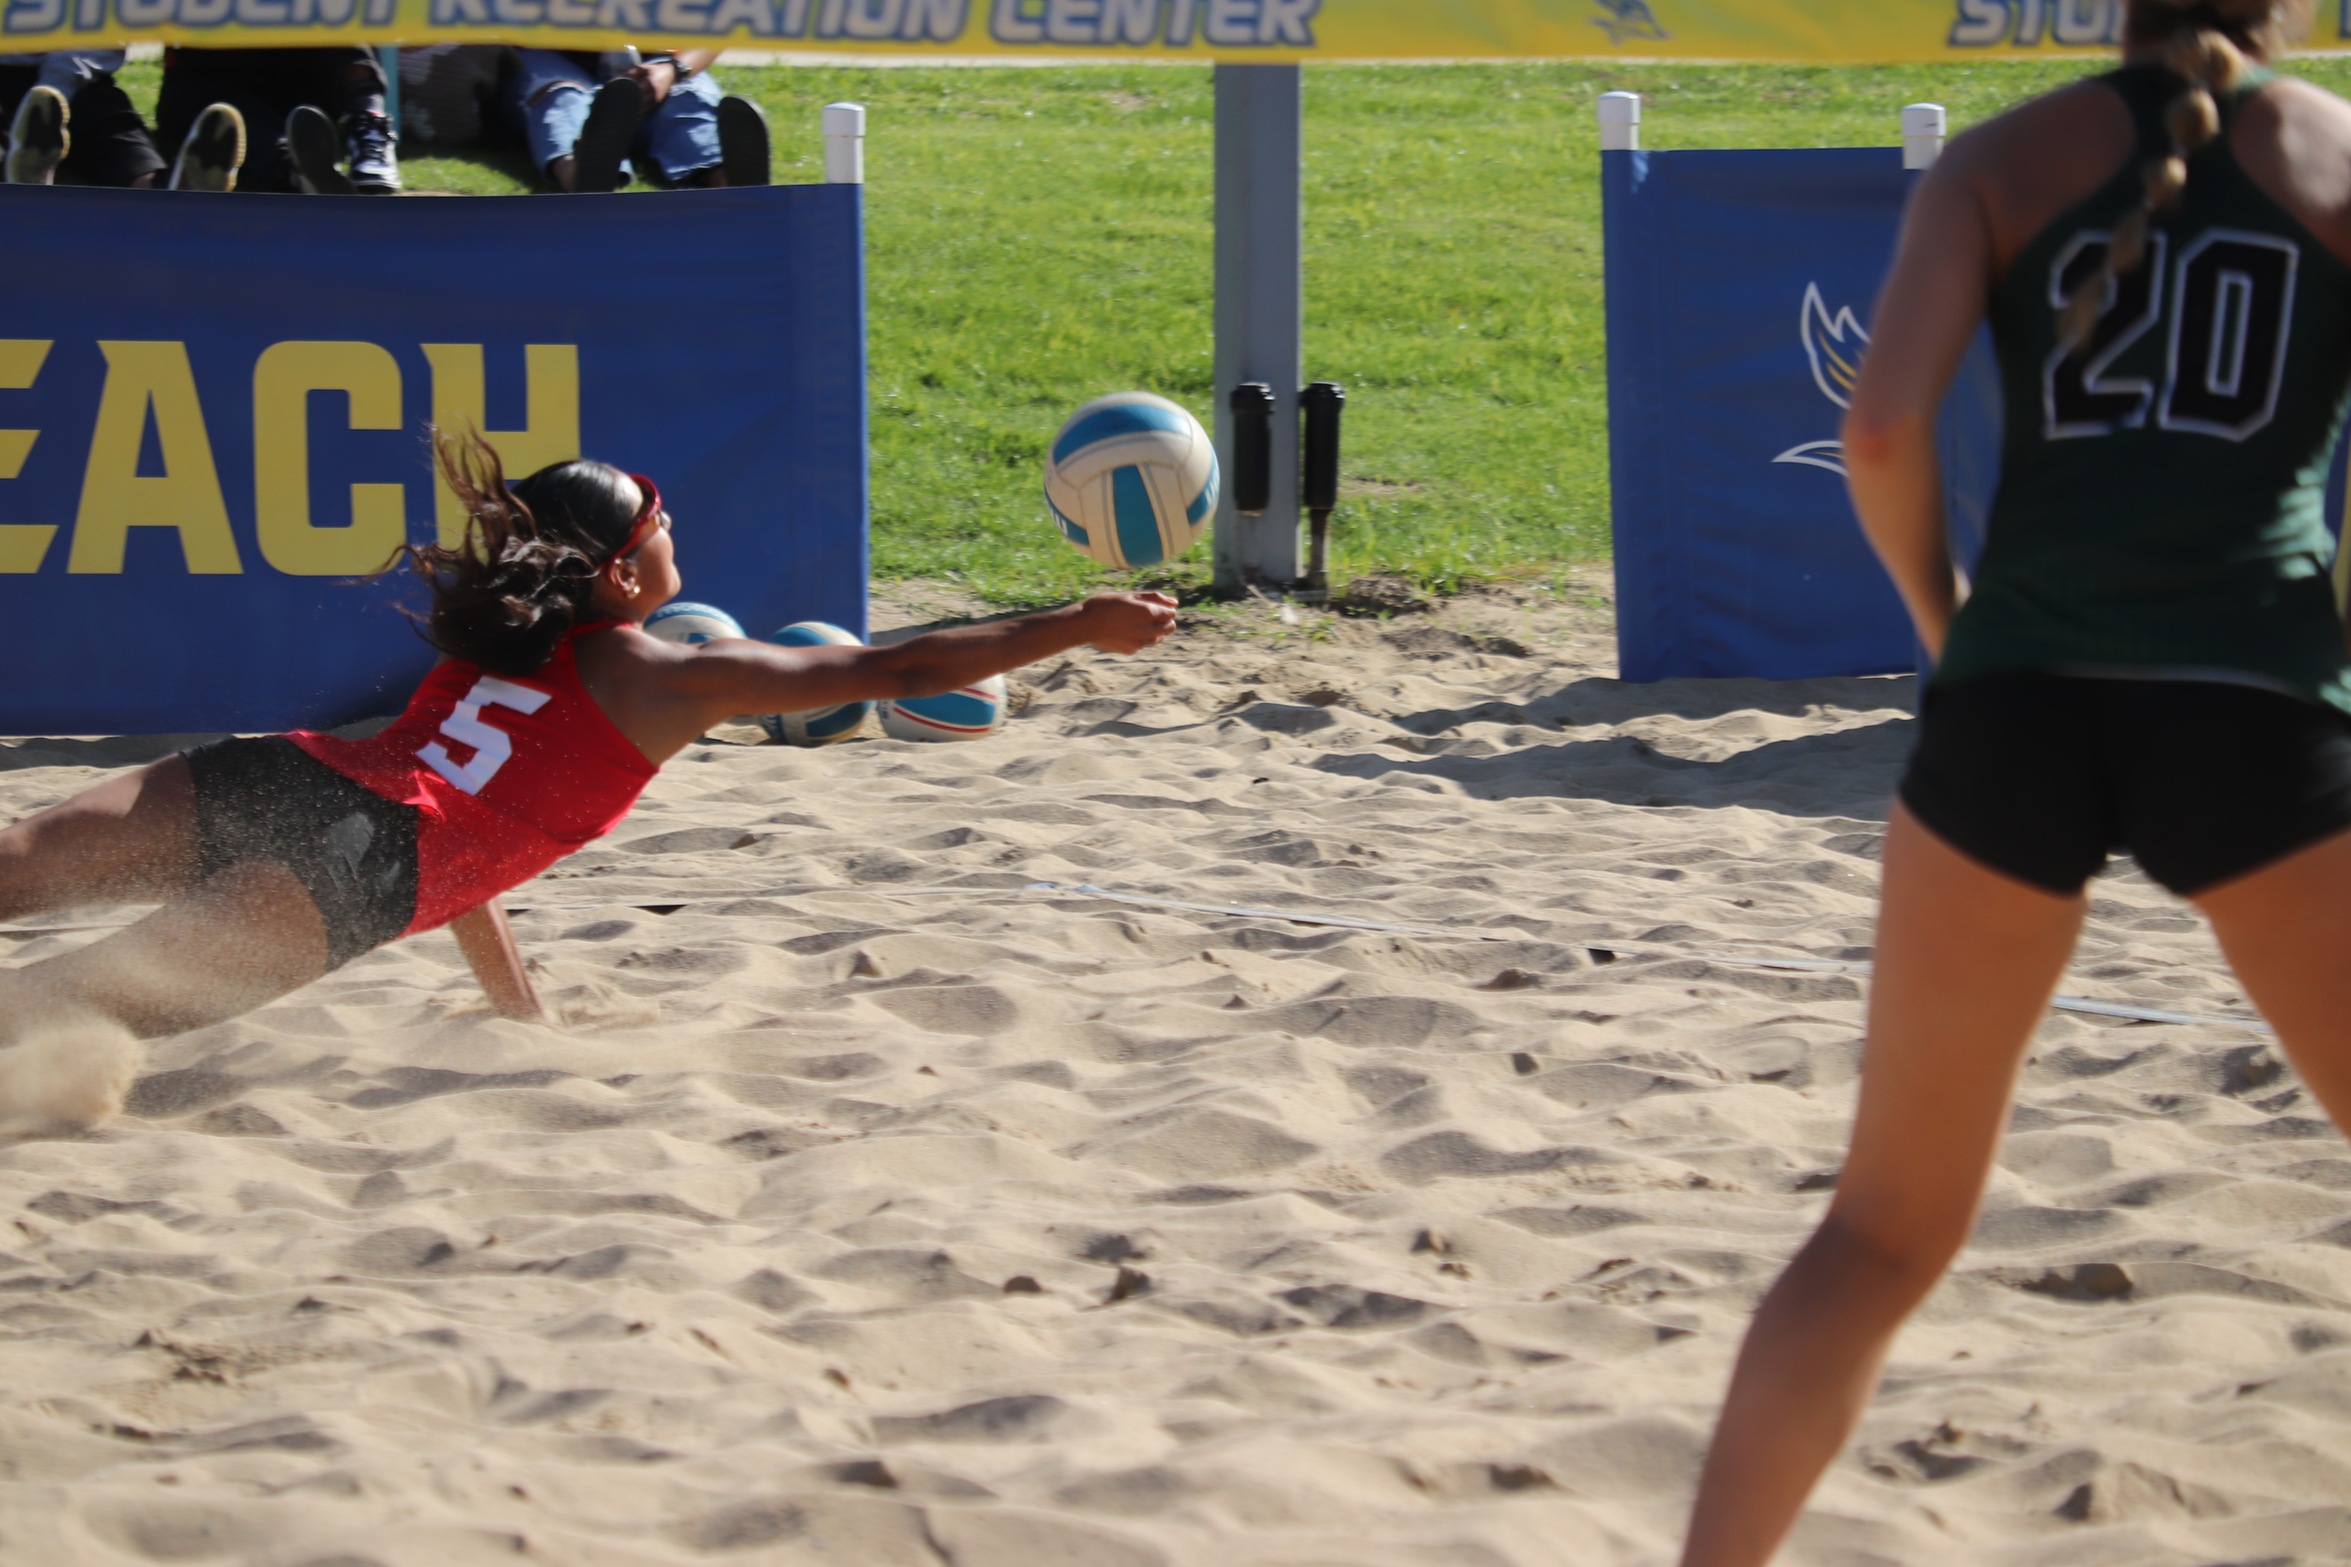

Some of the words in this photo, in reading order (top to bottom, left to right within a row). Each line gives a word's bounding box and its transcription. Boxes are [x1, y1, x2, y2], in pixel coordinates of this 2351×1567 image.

[988, 0, 1318, 46] CENTER
[2045, 228, 2302, 444] 20
[416, 675, 553, 797] 5
